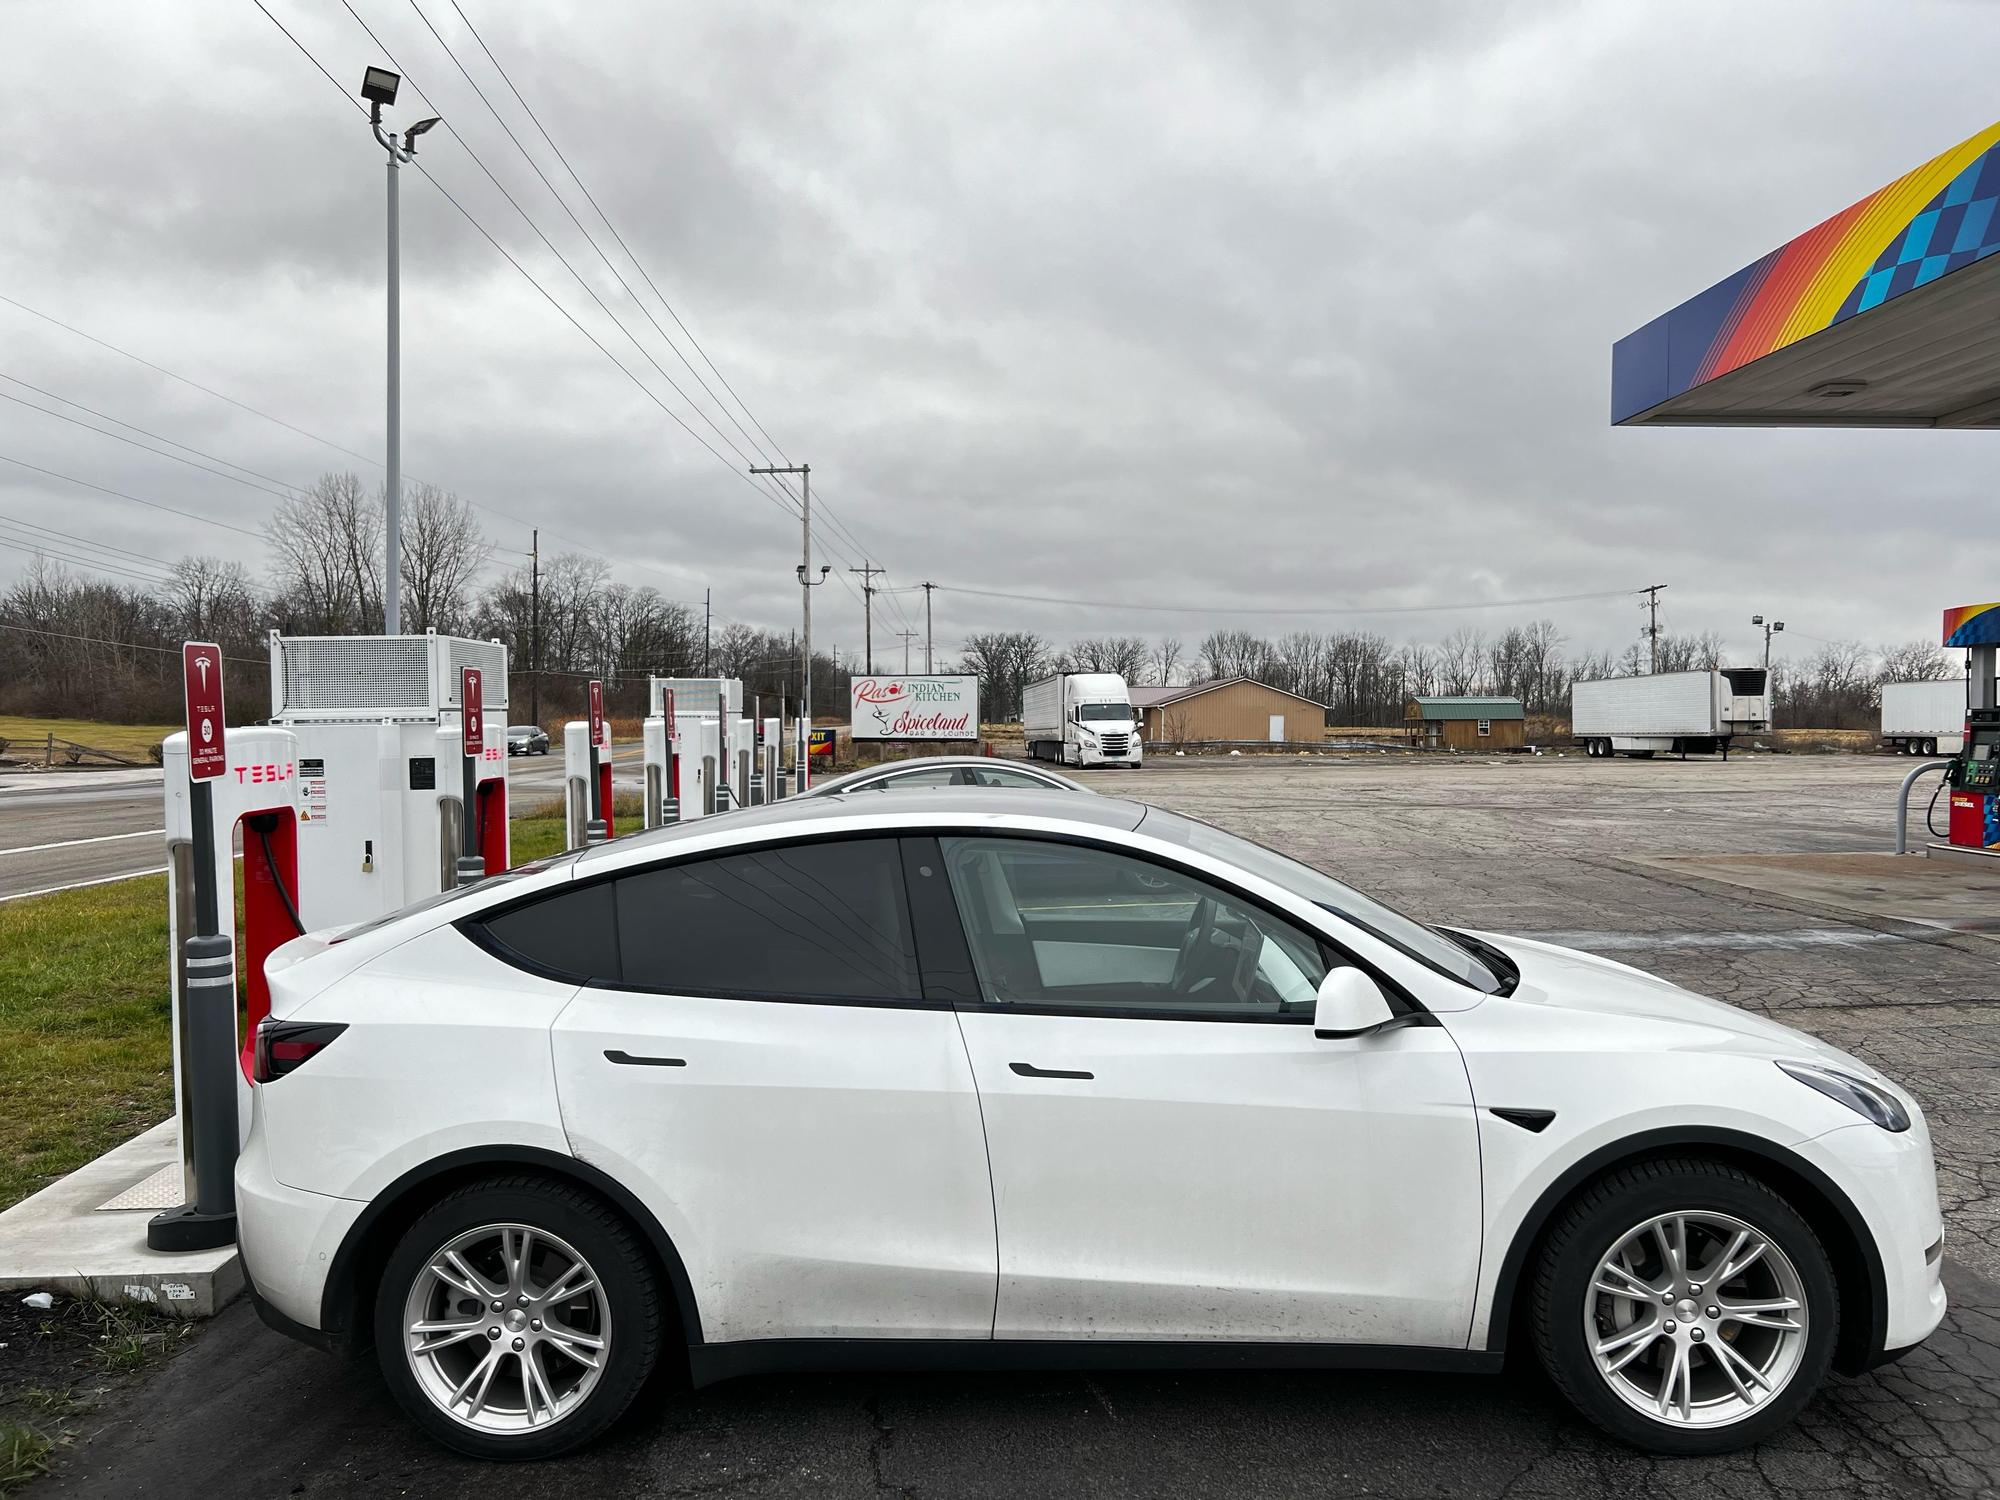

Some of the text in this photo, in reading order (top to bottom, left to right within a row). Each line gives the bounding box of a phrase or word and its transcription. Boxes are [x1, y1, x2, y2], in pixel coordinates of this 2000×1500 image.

[907, 683, 945, 693] INDIAN
[915, 692, 961, 702] KITCHEN
[893, 709, 969, 735] Spiceland
[811, 731, 826, 741] XIT
[234, 762, 293, 784] TESLA
